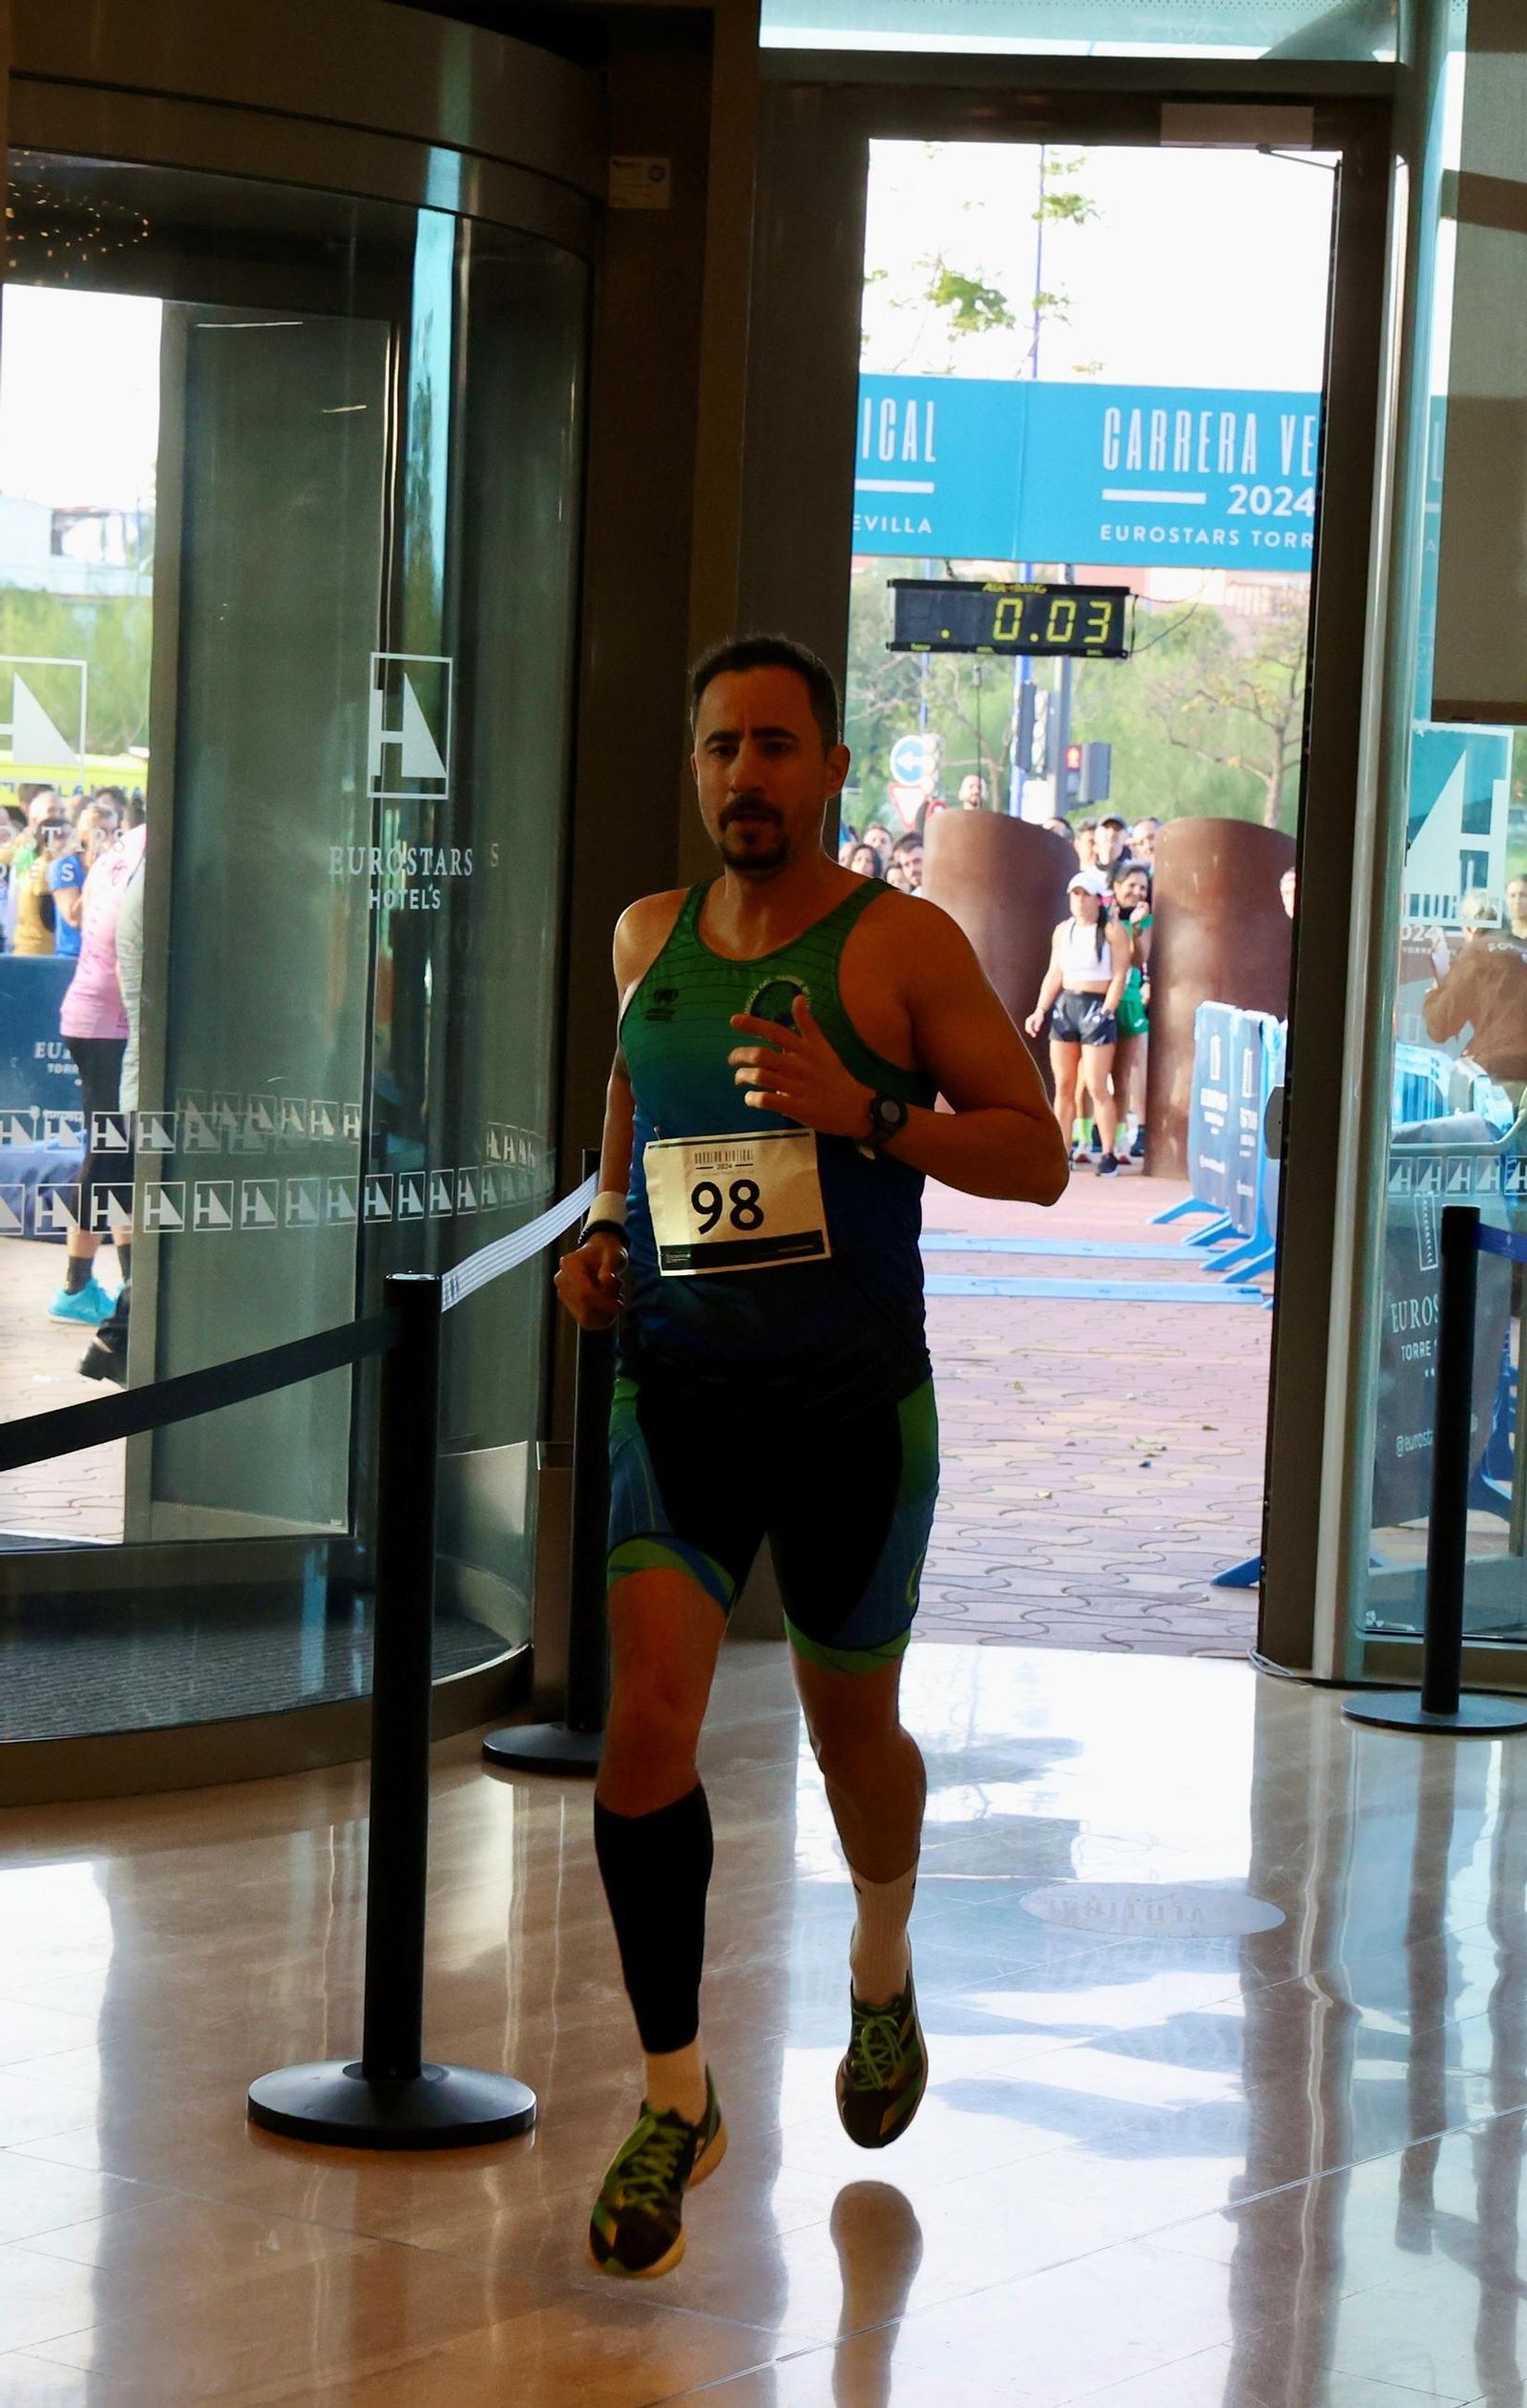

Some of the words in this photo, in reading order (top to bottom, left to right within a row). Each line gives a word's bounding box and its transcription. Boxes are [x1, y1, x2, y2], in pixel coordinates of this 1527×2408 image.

[862, 397, 936, 463] ICAL
[1102, 407, 1257, 474] CARRERA
[1281, 414, 1316, 477] VE
[1226, 483, 1316, 517] 2024
[1099, 524, 1240, 546] EUROSTARS
[328, 843, 473, 876] EUROSTARS
[691, 1180, 764, 1235] 98
[1401, 1340, 1432, 1362] TORRE
